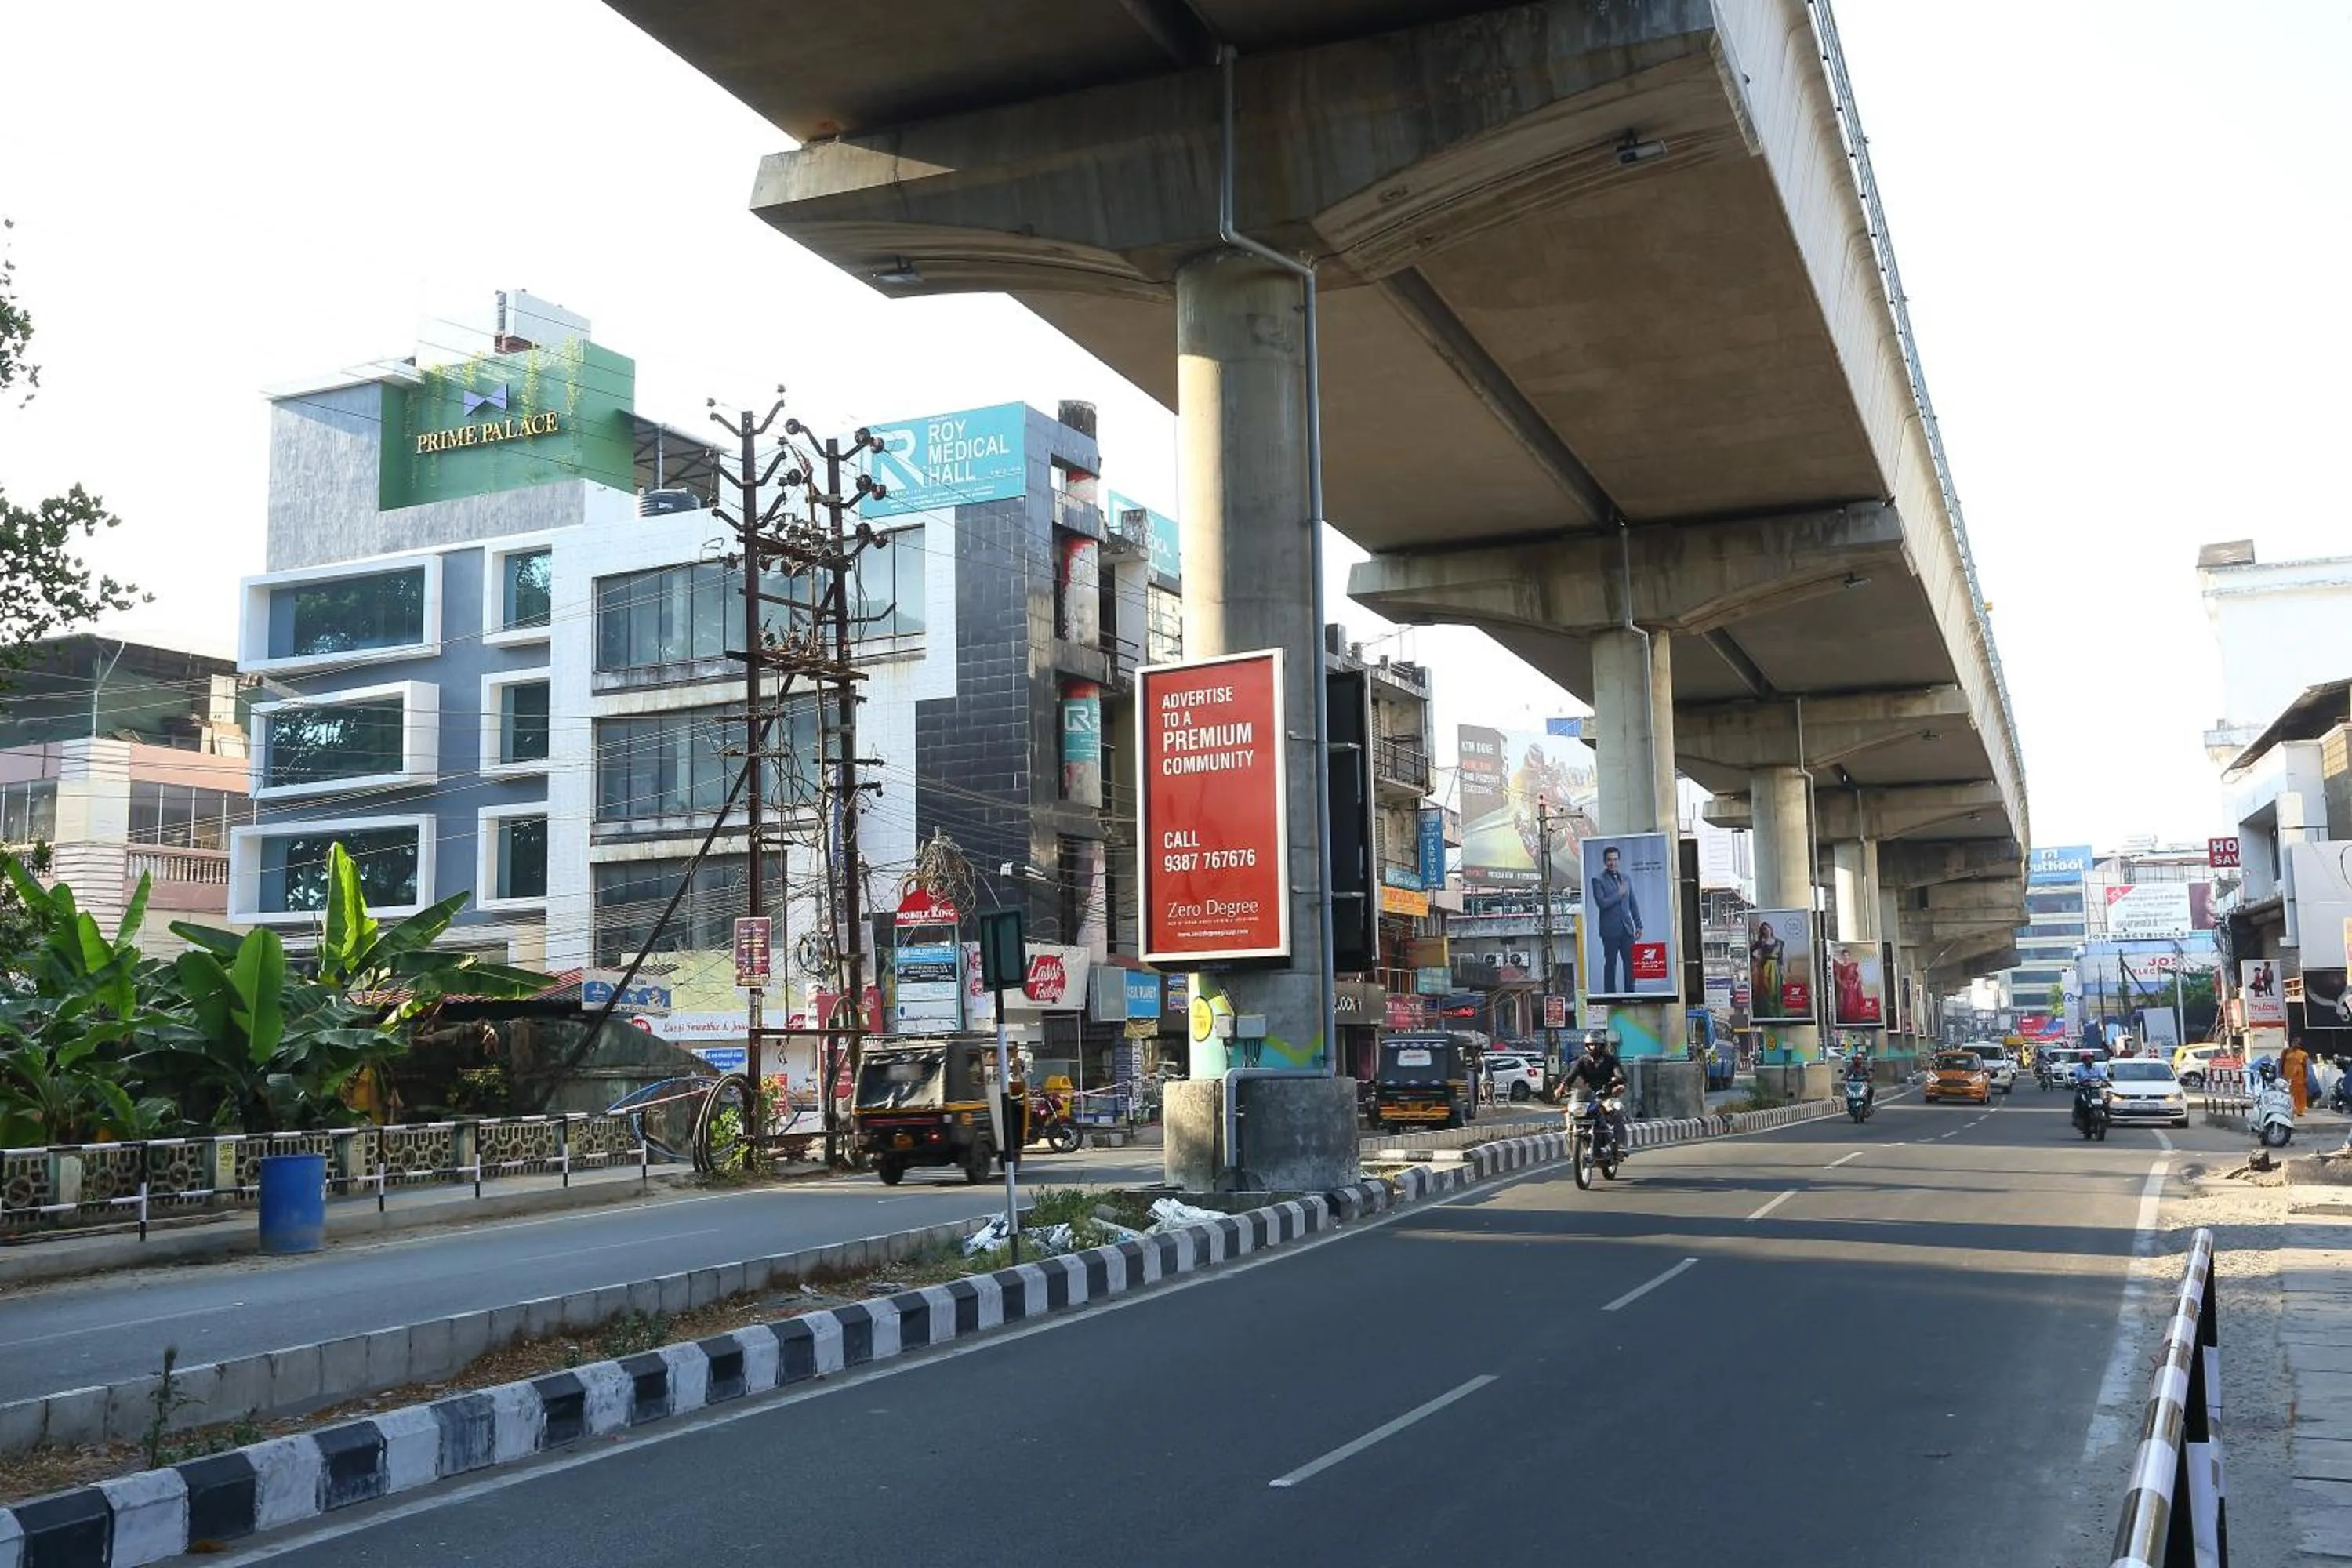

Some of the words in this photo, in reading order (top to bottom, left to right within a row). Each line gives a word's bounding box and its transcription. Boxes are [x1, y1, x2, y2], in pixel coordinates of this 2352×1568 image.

[415, 424, 477, 454] PRIME
[481, 412, 560, 443] PALACE
[928, 419, 967, 444] ROY
[928, 434, 1011, 465] MEDICAL
[928, 461, 977, 487] HALL
[1162, 687, 1234, 709] ADVERTISE
[1163, 712, 1179, 728] TO
[1183, 710, 1192, 726] A
[1163, 722, 1253, 753] PREMIUM
[1163, 749, 1254, 775] COMMUNITY
[1163, 829, 1200, 849] CALL
[2212, 839, 2238, 853] HO
[1163, 853, 1198, 873] 9387
[1203, 848, 1256, 869] 767676
[1167, 902, 1201, 919] Zero
[1207, 898, 1259, 918] Degree
